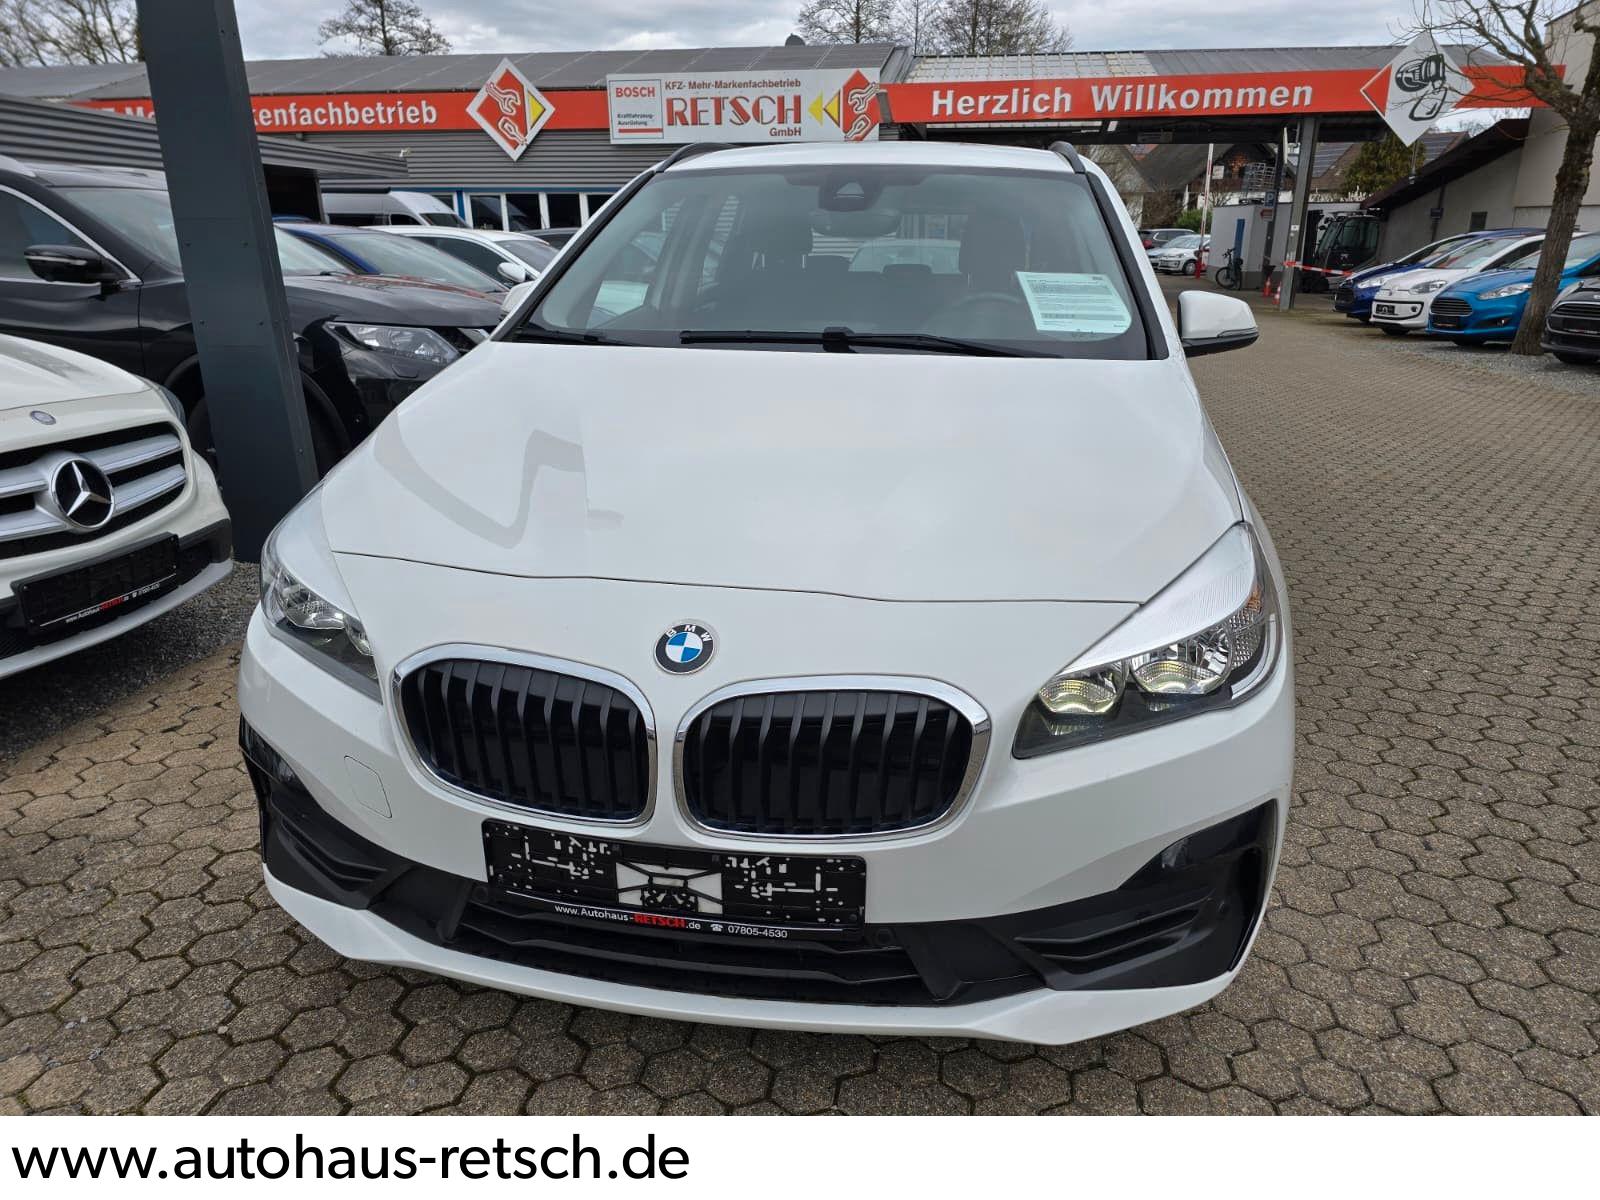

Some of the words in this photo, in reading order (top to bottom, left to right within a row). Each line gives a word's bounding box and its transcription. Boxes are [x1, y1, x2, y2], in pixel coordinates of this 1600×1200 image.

[615, 87, 656, 98] BOSCH
[665, 81, 686, 90] KFZ-
[688, 78, 801, 90] Mehr-Markenfachbetrieb
[931, 87, 1072, 116] Herzlich
[1091, 84, 1313, 112] Willkommen
[665, 95, 802, 126] RETSCH
[769, 127, 802, 137] GmbH
[665, 624, 713, 642] BMW
[554, 904, 701, 930] www.Autohaus-RETSCH.de
[727, 925, 788, 939] 07805-4530
